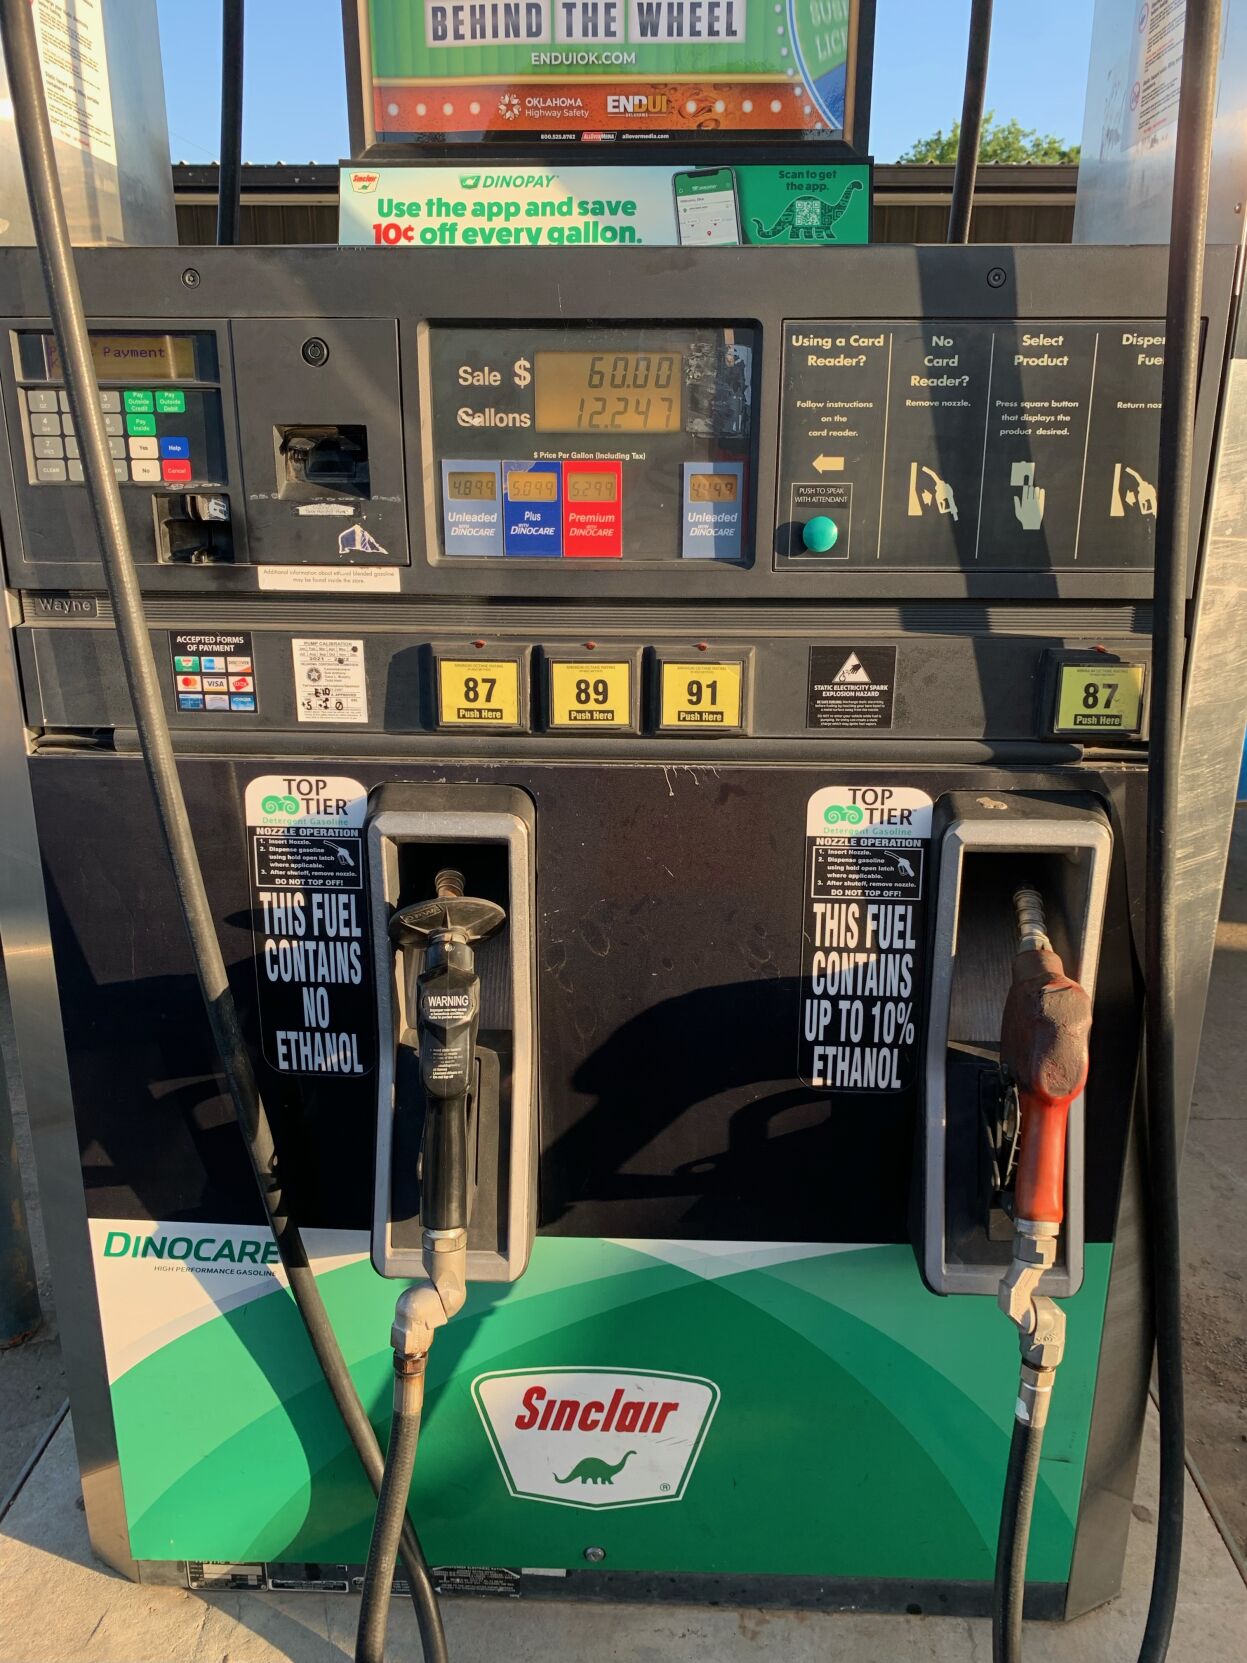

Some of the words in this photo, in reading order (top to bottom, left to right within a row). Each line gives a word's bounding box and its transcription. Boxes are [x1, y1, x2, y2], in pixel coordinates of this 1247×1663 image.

[431, 2, 544, 41] BEHIND
[562, 1, 617, 38] THE
[637, 0, 738, 38] WHEEL
[531, 51, 636, 66] ENDUIOK.COM
[525, 97, 583, 108] OKLAHOMA
[607, 95, 667, 112] ENDUI
[525, 108, 561, 119] Highway
[562, 108, 589, 119] Safety
[352, 175, 377, 183] Sinclair
[483, 175, 555, 188] DINOPAY
[778, 170, 804, 179] Scan
[806, 170, 816, 179] to
[818, 170, 837, 181] get
[786, 182, 803, 190] the
[805, 183, 829, 192] app.
[377, 197, 422, 217] Use
[426, 196, 460, 217] the
[472, 200, 518, 222] app
[525, 196, 573, 216] and
[578, 200, 637, 217] save
[373, 224, 414, 244] 10¢
[420, 222, 463, 244] off
[467, 226, 537, 245] every
[550, 222, 642, 245] gallon.
[792, 336, 832, 348] Using
[836, 338, 845, 346] a
[850, 335, 884, 347] Card
[932, 336, 954, 346] No
[1022, 334, 1064, 346] Select
[104, 346, 166, 358] Payment
[808, 354, 866, 366] Reader?
[924, 355, 958, 367] Card
[1014, 354, 1069, 367] Product
[458, 366, 501, 386] Sale
[514, 357, 531, 388] $
[588, 356, 674, 388] 60.00
[910, 375, 970, 388] Reader?
[1020, 401, 1049, 409] square
[457, 408, 531, 428] Gallons
[578, 397, 674, 429] 12.247
[1020, 414, 1054, 423] displays
[1000, 428, 1032, 437] product
[1036, 428, 1070, 436] desired.
[595, 452, 630, 460] (Including
[632, 452, 646, 460] Tax)
[453, 480, 494, 496] 4.899
[512, 480, 554, 496] 5.099
[572, 480, 613, 496] 5.299
[448, 512, 497, 523] Unleaded
[524, 511, 541, 522] Plus
[568, 513, 615, 523] Premium
[688, 512, 737, 523] Unleaded
[451, 527, 496, 536] DINOCARE
[510, 526, 555, 535] DINOCARE
[569, 527, 614, 537] DINOCARE
[690, 527, 734, 536] DINOCARE
[39, 598, 91, 614] Wayne
[464, 678, 497, 703] 87
[576, 679, 608, 705] 89
[687, 680, 718, 705] 91
[1082, 682, 1119, 709] 87
[459, 709, 481, 719] Push
[482, 709, 501, 719] Here
[571, 710, 592, 720] Push
[594, 710, 613, 720] Here
[679, 712, 701, 722] Push
[702, 712, 722, 722] Here
[1076, 715, 1096, 725] Push
[1098, 715, 1120, 726] Here
[283, 778, 327, 796] TOP
[848, 788, 893, 806] TOP
[301, 798, 348, 816] TIER
[262, 816, 307, 825] Detergent
[310, 817, 349, 826] Gasoline
[865, 808, 912, 826] TIER
[299, 828, 359, 837] OPERATION
[824, 827, 868, 835] Detergent
[872, 827, 912, 835] Gasoline
[816, 838, 857, 846] NOZZLE
[860, 838, 922, 847] OPERATION
[260, 892, 306, 936] THIS
[311, 894, 362, 937] FUEL
[813, 903, 860, 949] THIS
[866, 905, 916, 949] FUEL
[265, 939, 362, 984] CONTAINS
[812, 951, 913, 998] CONTAINS
[302, 986, 330, 1029] NO
[428, 995, 469, 1007] WARNING
[804, 998, 832, 1042] UP
[838, 1000, 864, 1042] TO
[872, 1002, 915, 1045] 10%
[276, 1030, 364, 1073] ETHANOL
[812, 1045, 902, 1089] ETHANOL
[104, 1232, 279, 1264] DINOCARE
[175, 1266, 235, 1275] PERFORMANCE
[236, 1269, 277, 1277] GASOLINE
[514, 1386, 680, 1434] Sinclair
